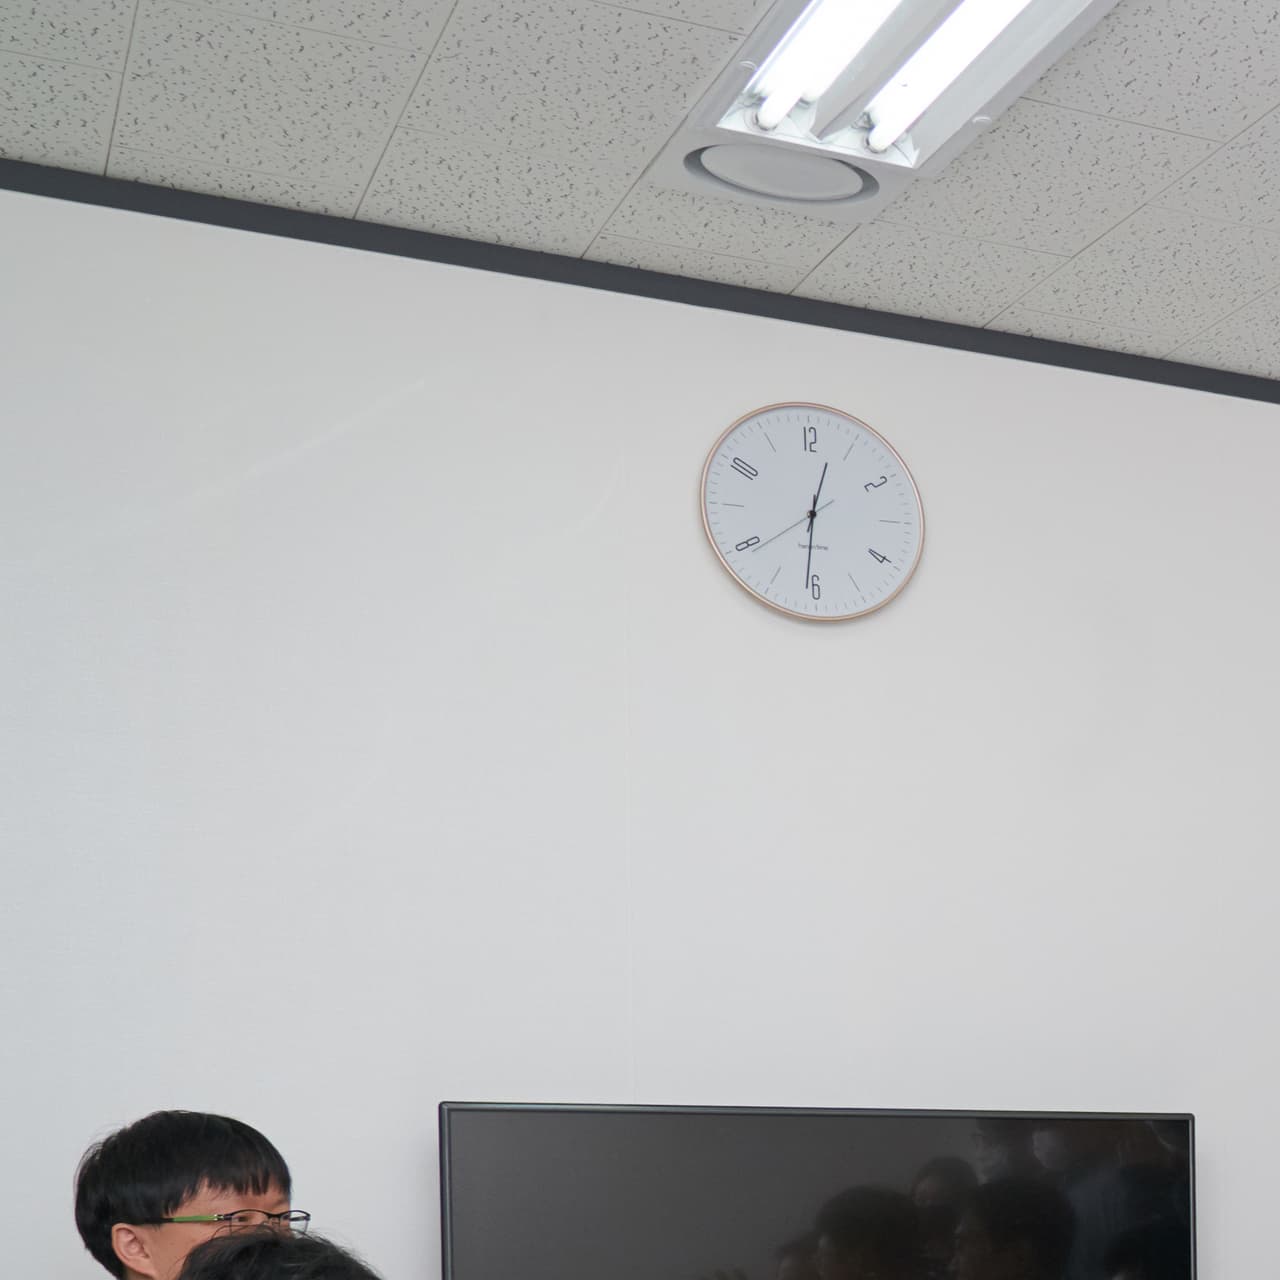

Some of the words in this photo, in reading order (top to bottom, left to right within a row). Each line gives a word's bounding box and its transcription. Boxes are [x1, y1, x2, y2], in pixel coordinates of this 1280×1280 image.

[803, 426, 817, 453] 12
[730, 457, 759, 481] 10
[863, 475, 888, 492] 2
[735, 536, 760, 551] 8
[868, 547, 892, 563] 4
[811, 574, 821, 600] 6
